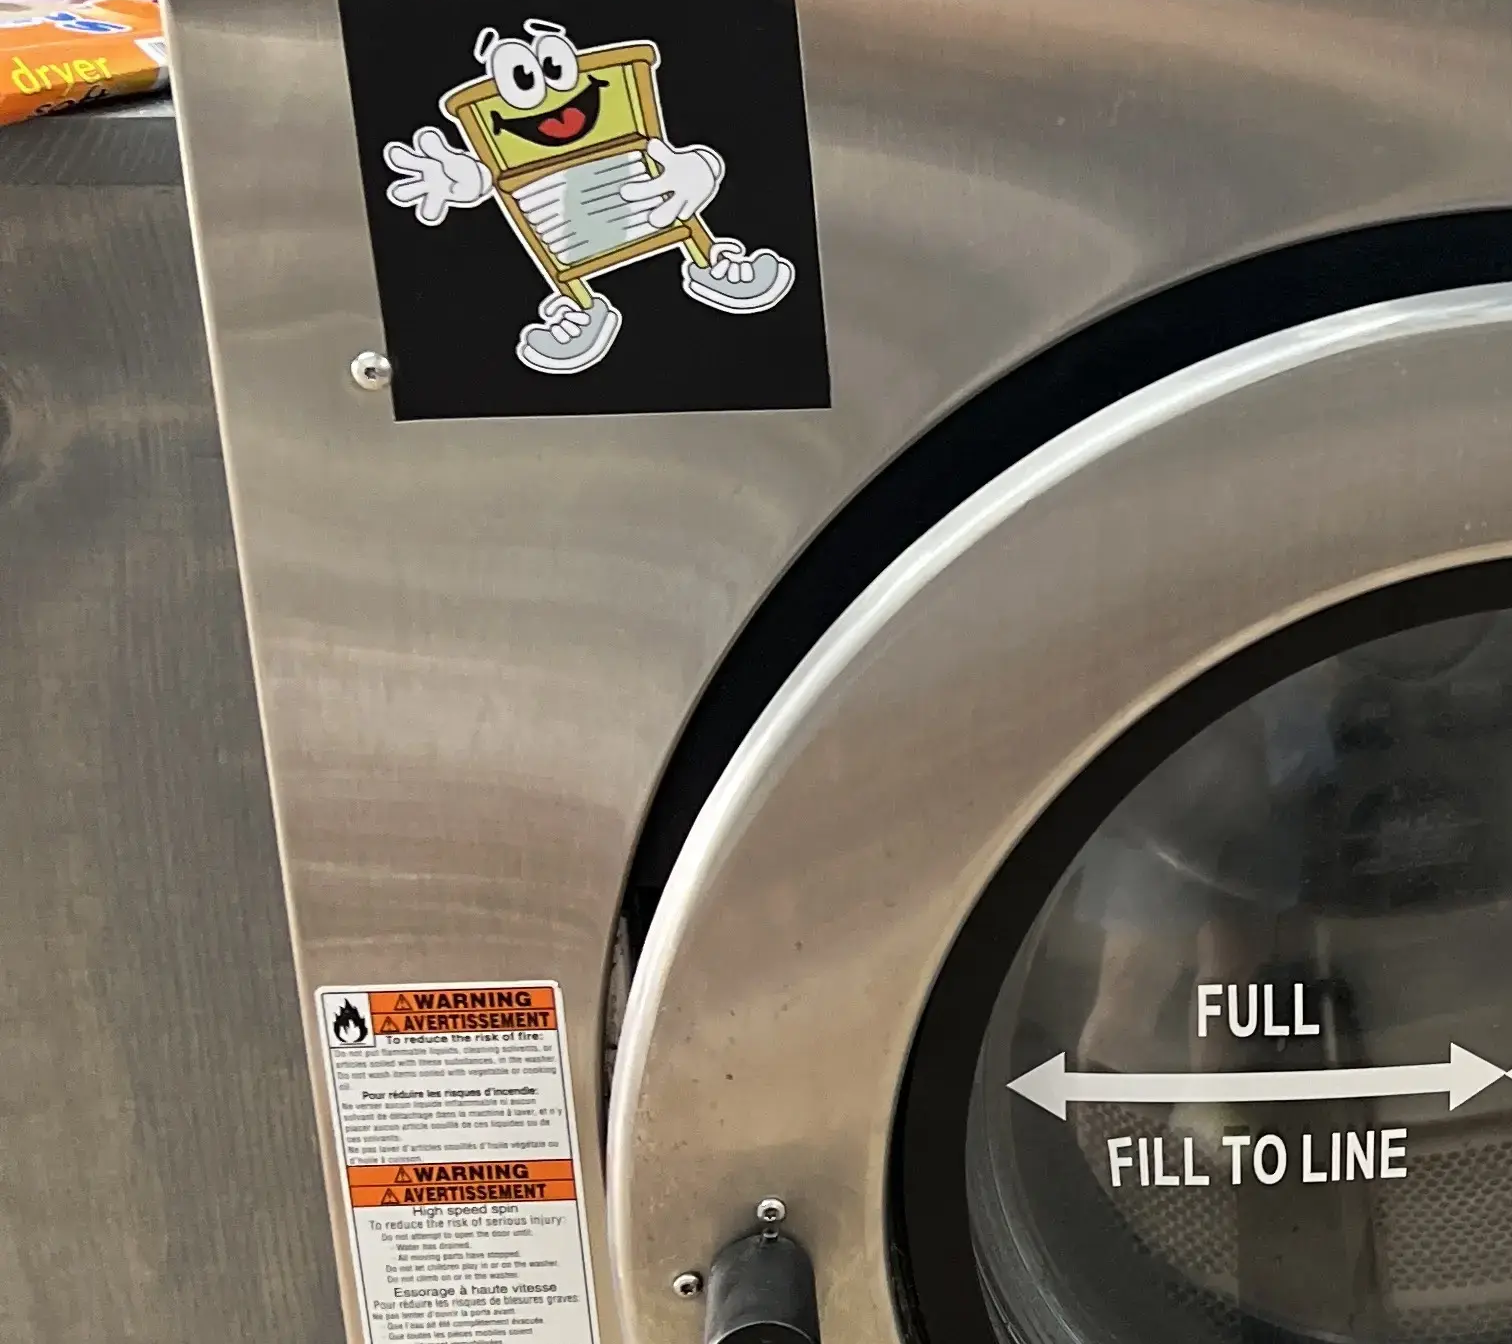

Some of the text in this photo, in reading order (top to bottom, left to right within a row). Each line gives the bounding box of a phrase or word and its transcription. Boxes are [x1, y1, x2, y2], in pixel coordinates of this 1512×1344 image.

[11, 56, 112, 99] dryer
[413, 992, 531, 1009] WARNING
[1196, 984, 1320, 1039] FULL
[404, 1012, 549, 1031] AVERTISSEMENT
[385, 1032, 544, 1044] To reduce the risk of fire:
[362, 1091, 385, 1100] Pour
[1108, 1128, 1408, 1188] FILL TO LINE
[413, 1164, 529, 1182] WARNING
[404, 1184, 546, 1203] AVERTISSEMENT
[413, 1203, 518, 1218] High speed spin
[369, 1220, 382, 1229] To
[385, 1219, 423, 1229] reduce
[426, 1218, 445, 1228] the
[448, 1217, 468, 1227] risk
[472, 1217, 485, 1227] of
[486, 1217, 527, 1226] serious
[394, 1283, 557, 1298] Essorage à haute vitesse
